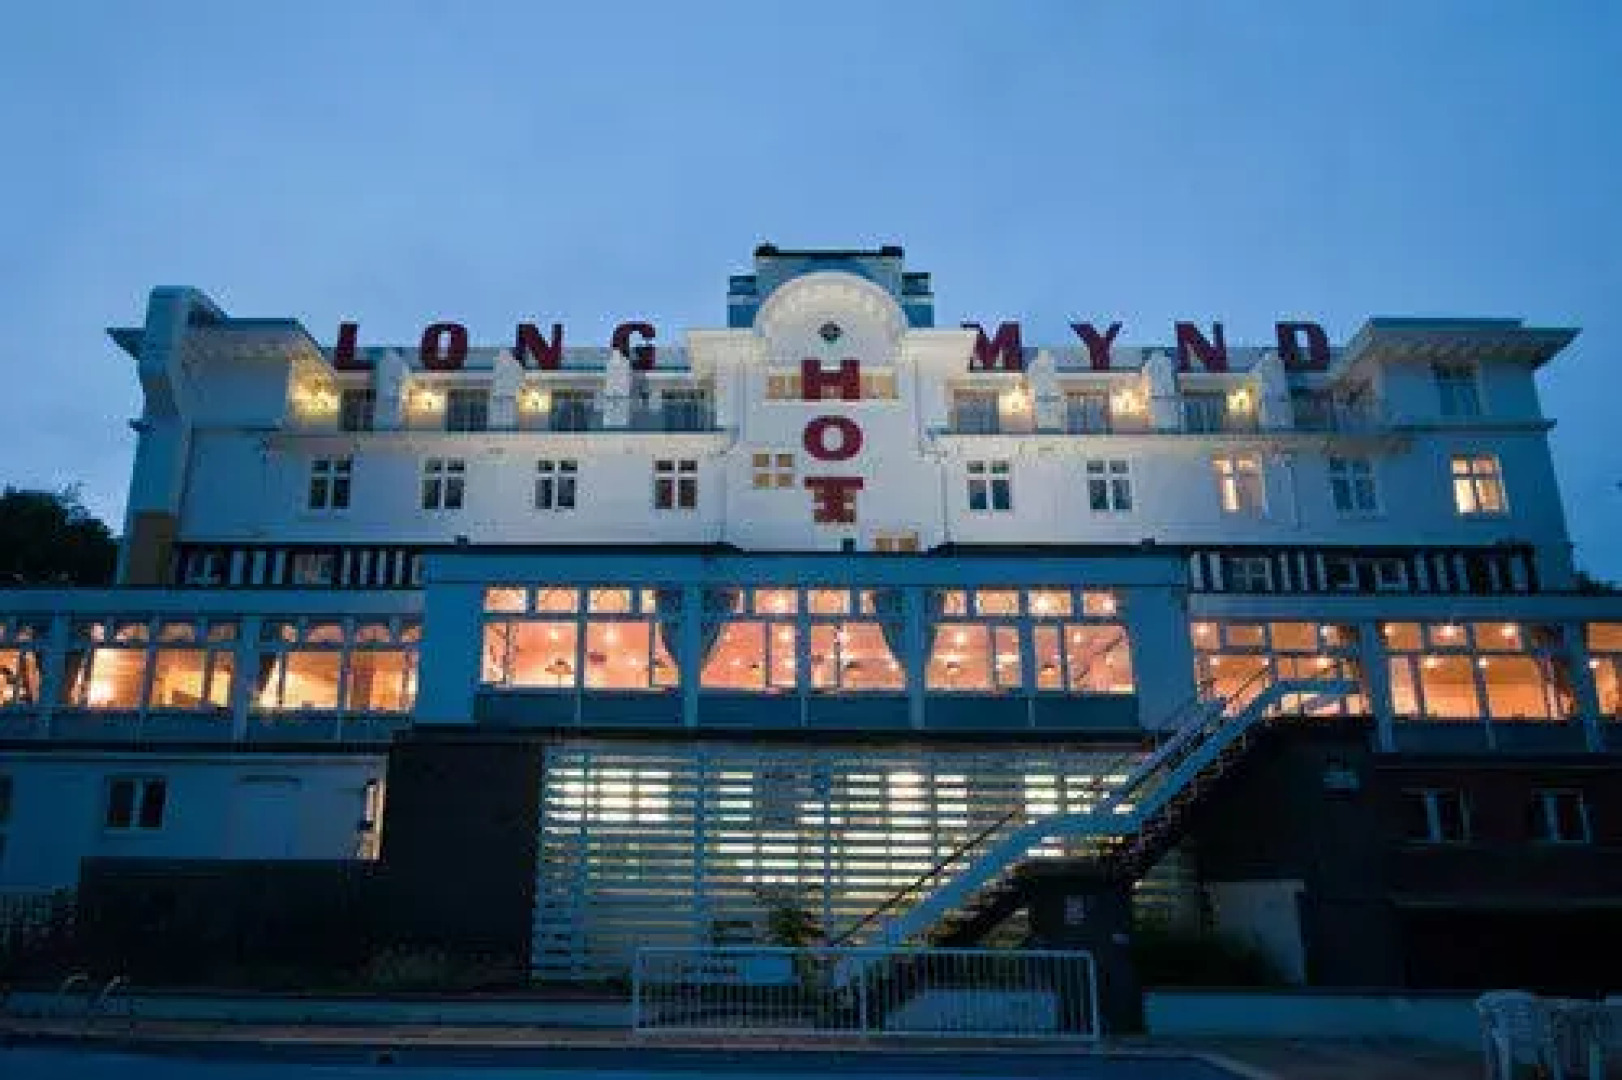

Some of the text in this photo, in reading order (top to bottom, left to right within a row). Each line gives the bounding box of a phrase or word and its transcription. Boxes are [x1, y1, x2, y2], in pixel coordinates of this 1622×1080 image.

[334, 320, 1330, 370] LONG MYND
[801, 359, 864, 523] HOT
